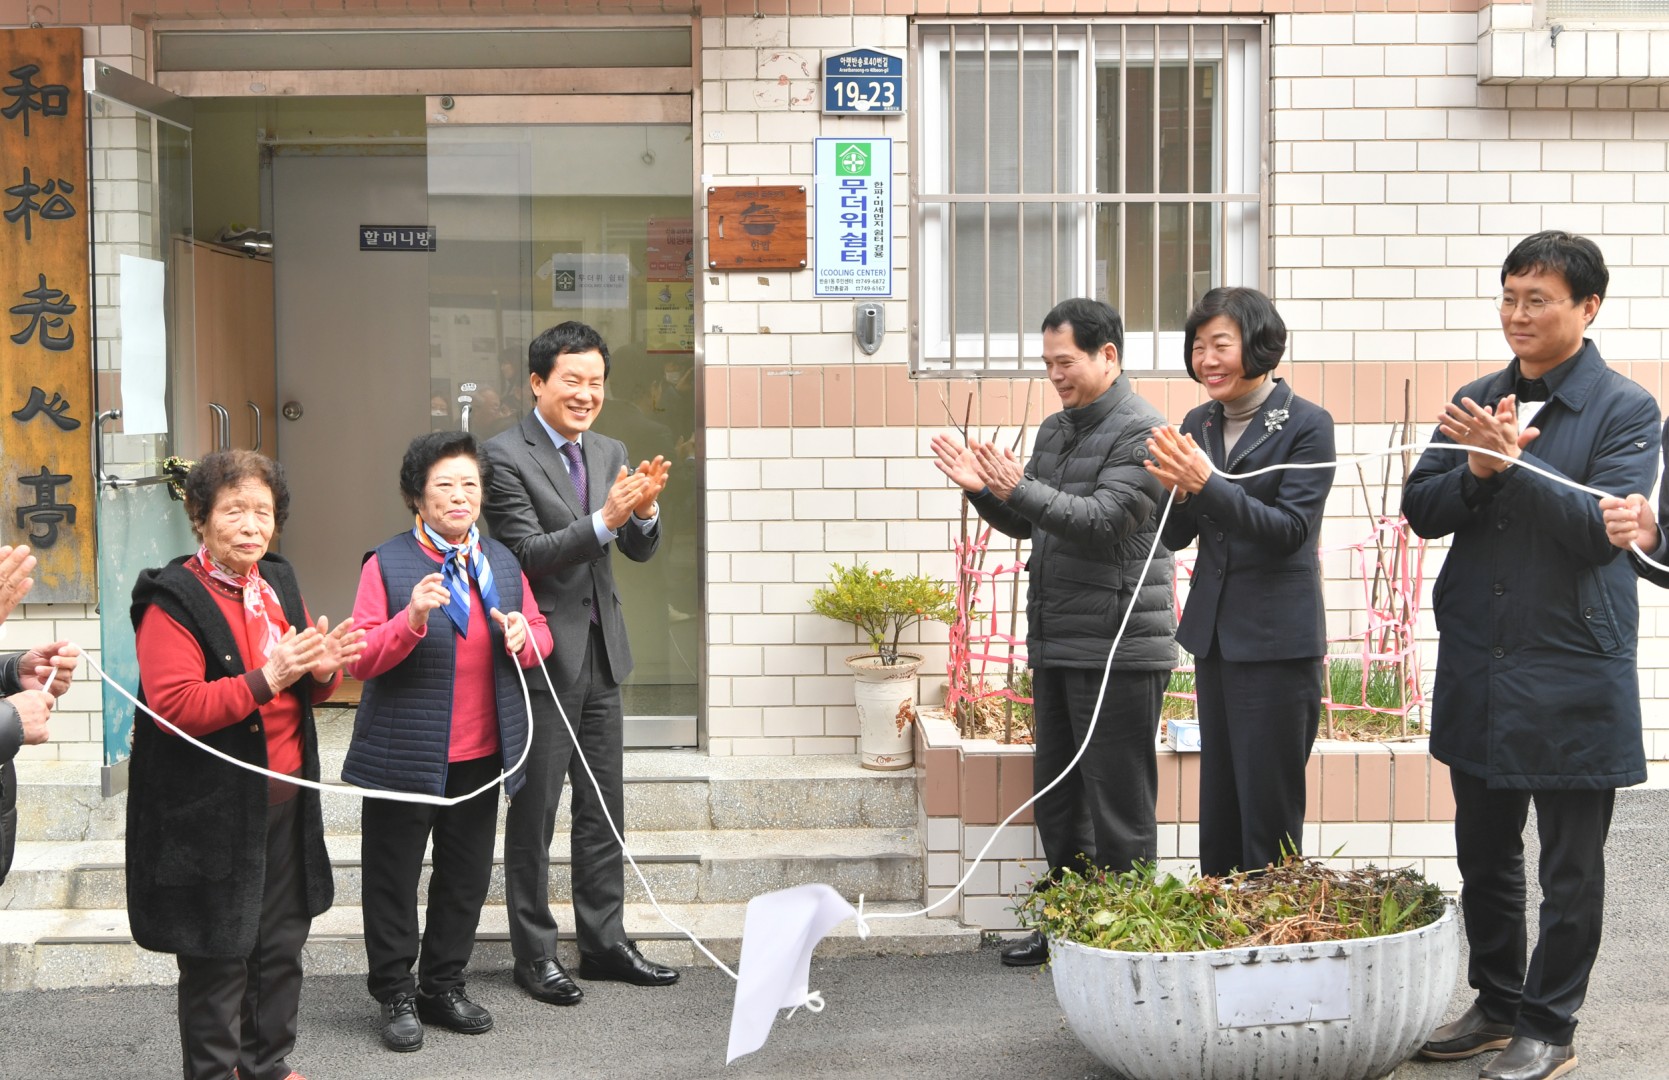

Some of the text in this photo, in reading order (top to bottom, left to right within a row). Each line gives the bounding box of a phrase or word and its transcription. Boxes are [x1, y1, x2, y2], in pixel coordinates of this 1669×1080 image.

[833, 81, 895, 107] 19-23
[363, 230, 432, 247] 할머니방
[820, 269, 887, 277] (COOLING CENTER)
